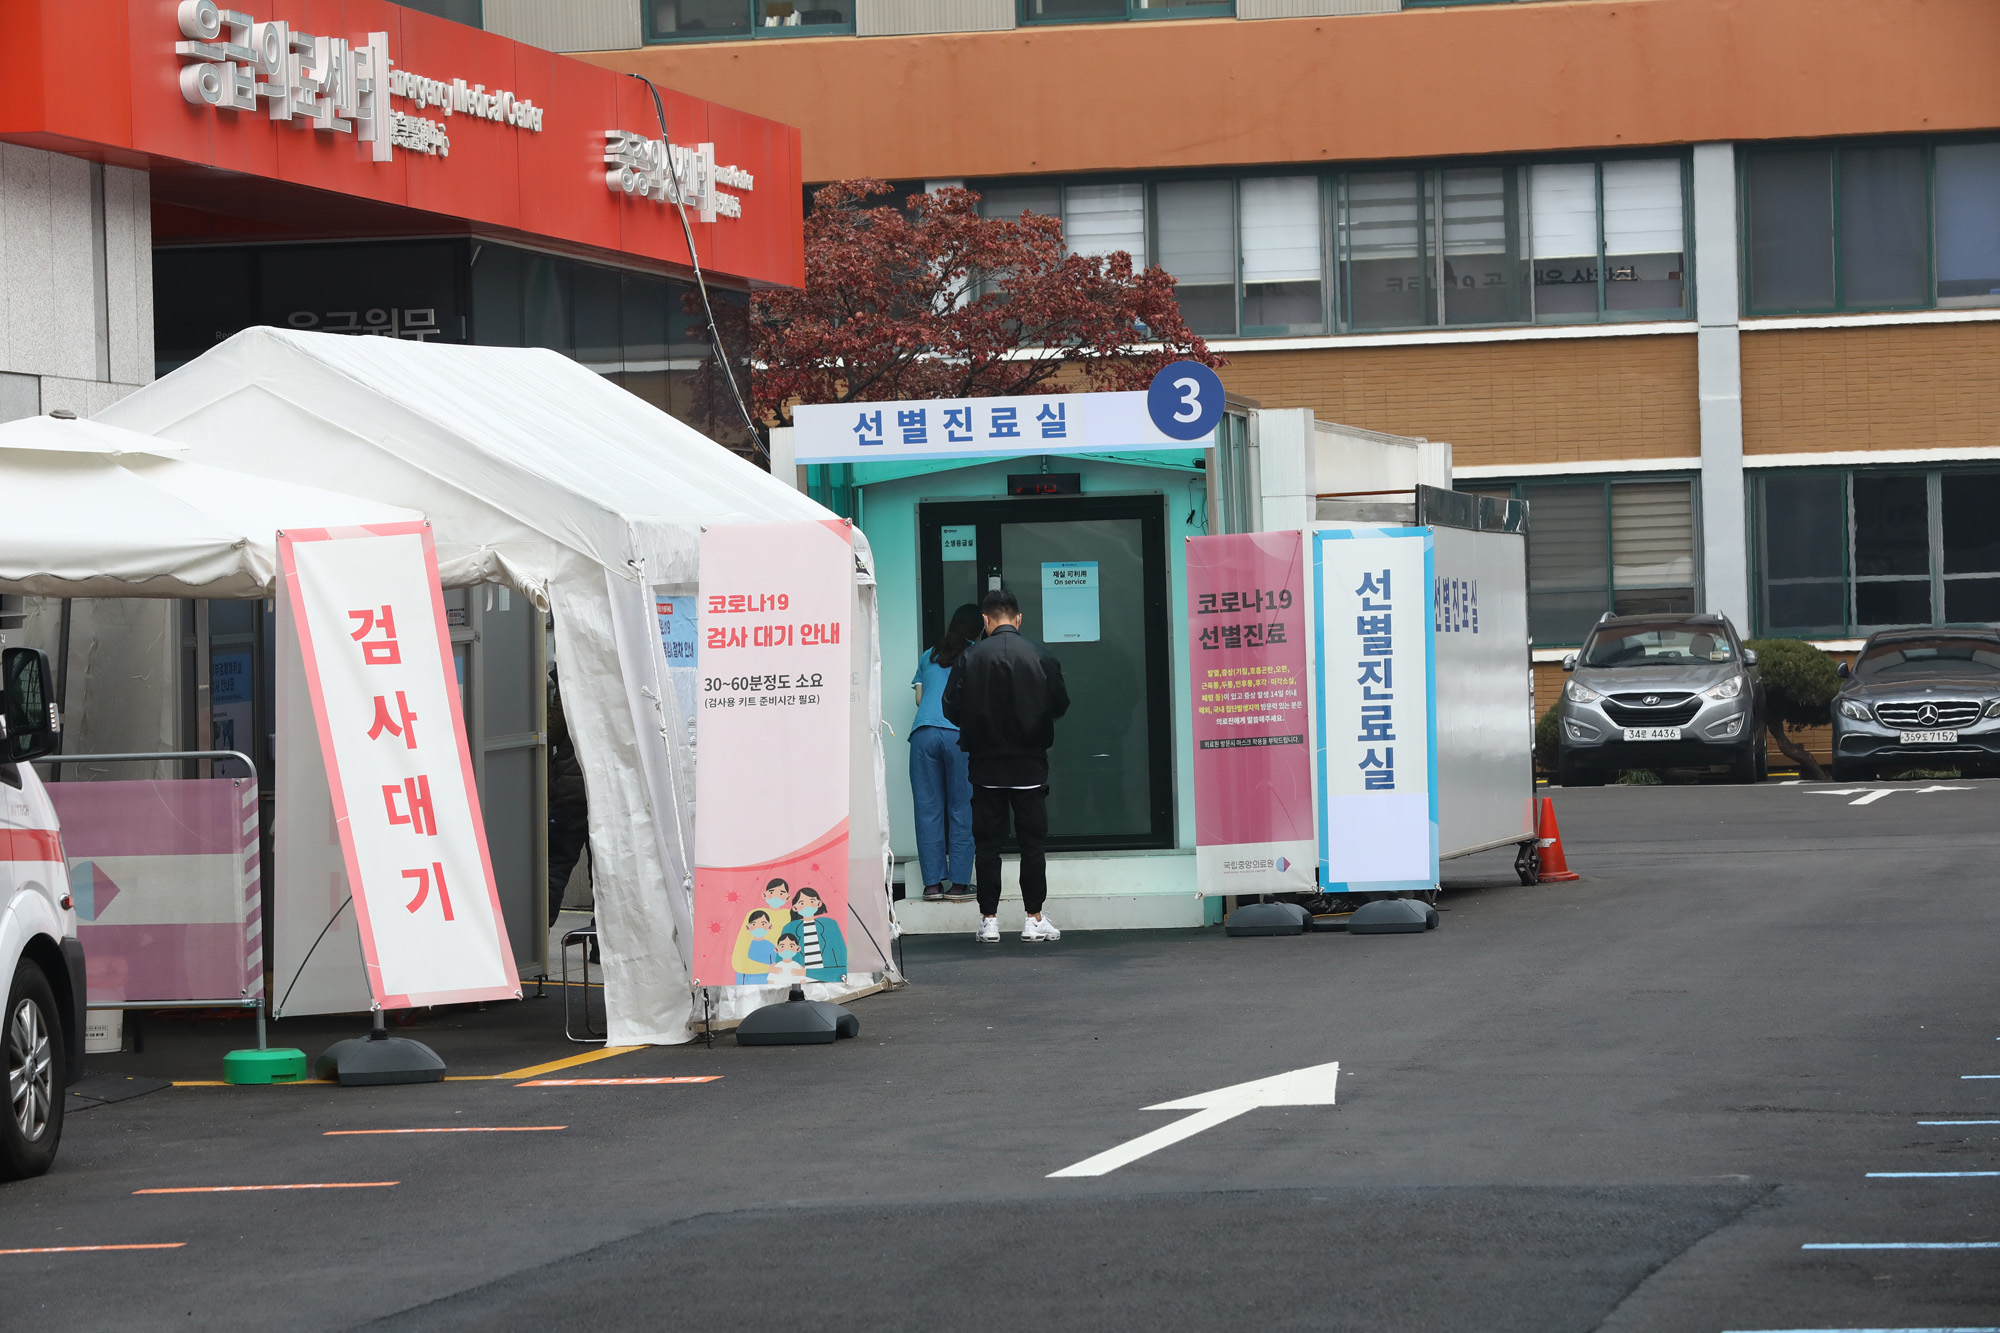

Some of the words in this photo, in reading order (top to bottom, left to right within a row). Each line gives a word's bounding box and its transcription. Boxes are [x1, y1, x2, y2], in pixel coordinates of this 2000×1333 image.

[175, 0, 393, 162] 응급의료센터
[453, 78, 503, 122] Medical
[503, 91, 543, 132] Center
[604, 130, 717, 222] 중증외상센터
[1173, 377, 1202, 423] 3
[853, 402, 1067, 446] 선별진료실
[707, 593, 789, 614] 코로나19
[1197, 589, 1293, 614] 코로나19
[707, 626, 748, 649] 검사
[754, 624, 793, 647] 대기
[800, 622, 840, 646] 안내
[1199, 623, 1287, 650] 선별진료
[704, 674, 791, 692] 30~60분정도
[795, 673, 823, 688] 소요
[1355, 569, 1396, 790] 선별진료실
[704, 696, 735, 709] (검사용
[738, 696, 757, 707] 키트
[759, 695, 796, 707] 준비시간
[799, 694, 820, 705] 필요)
[1270, 689, 1284, 698] 14일
[1651, 729, 1676, 738] 4436
[1223, 858, 1275, 870] 국립중앙의료원
